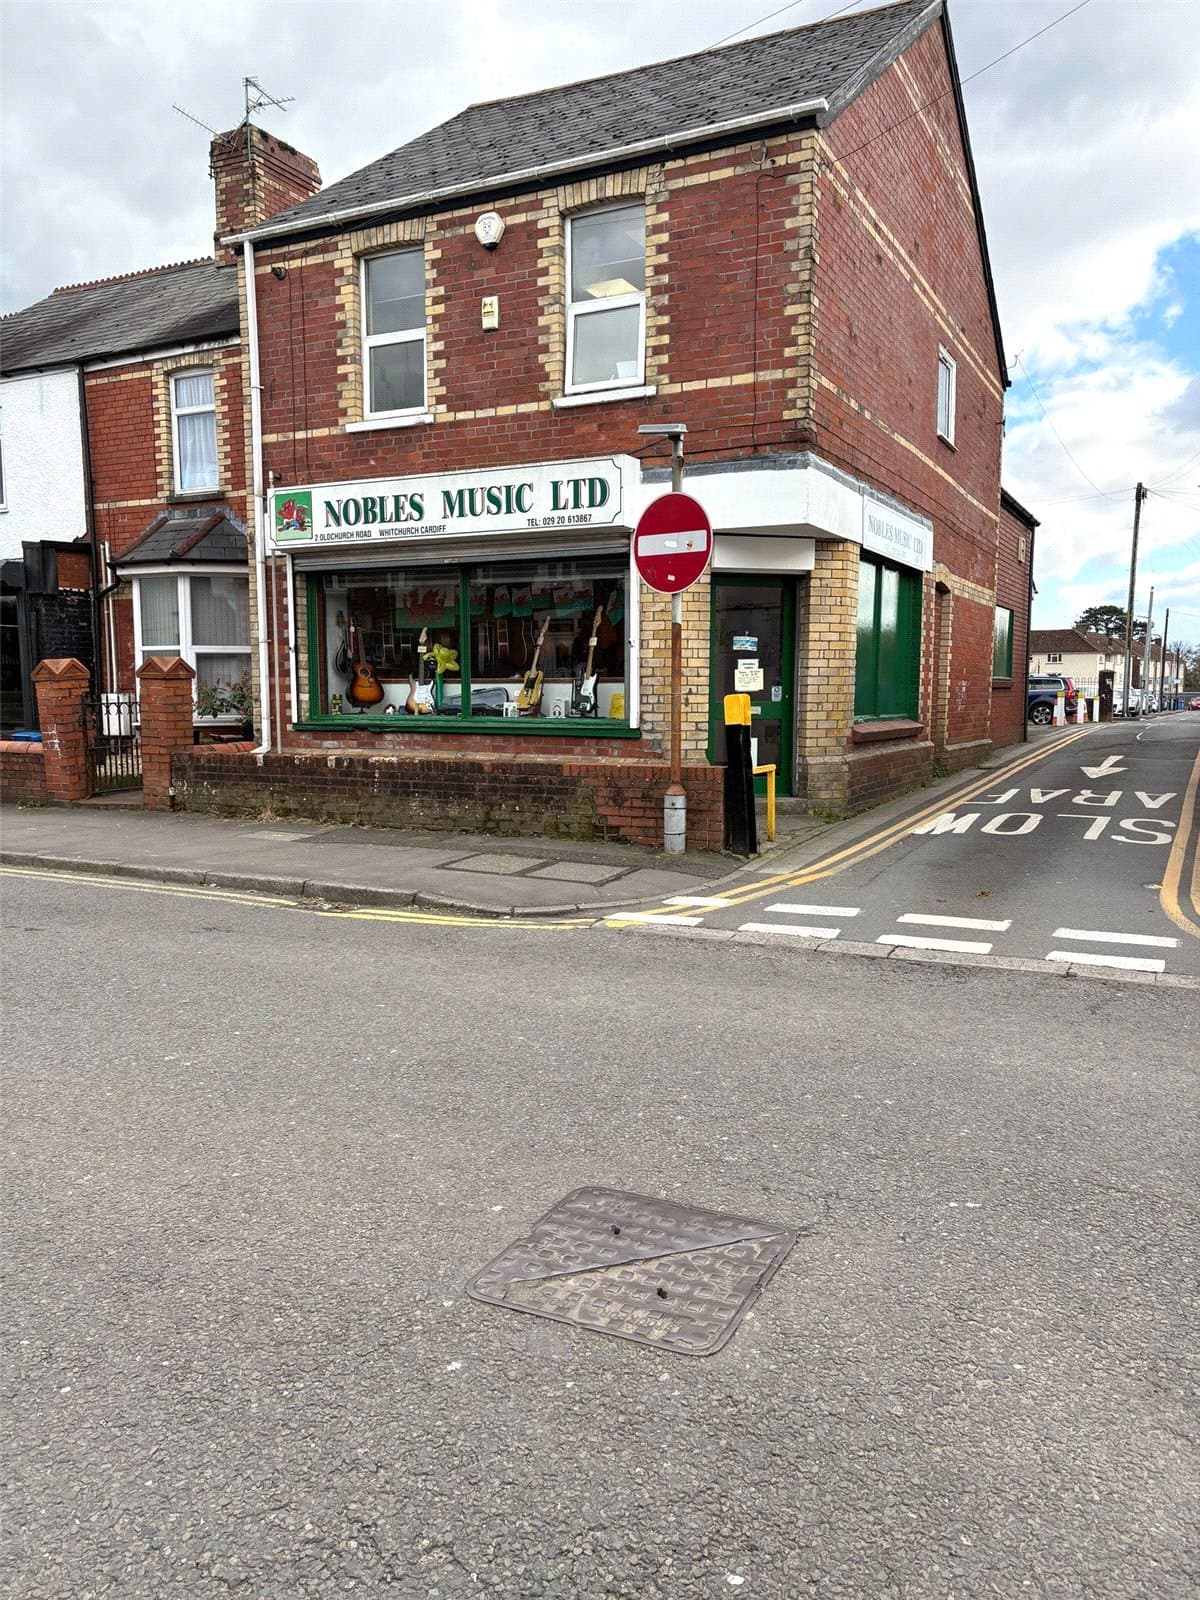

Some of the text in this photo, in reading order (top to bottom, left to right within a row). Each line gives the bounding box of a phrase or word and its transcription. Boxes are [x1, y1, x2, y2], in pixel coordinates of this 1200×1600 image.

[324, 477, 610, 528] NOBLES MUSIC LTD
[527, 513, 592, 526] TEL: 029 20 613867
[868, 515, 893, 542] NOBLES
[314, 533, 319, 541] 2
[355, 530, 372, 538] ROAD
[379, 526, 419, 536] WHITCHURCH
[963, 788, 1178, 808] ARAF
[911, 812, 1177, 845] SLOW
